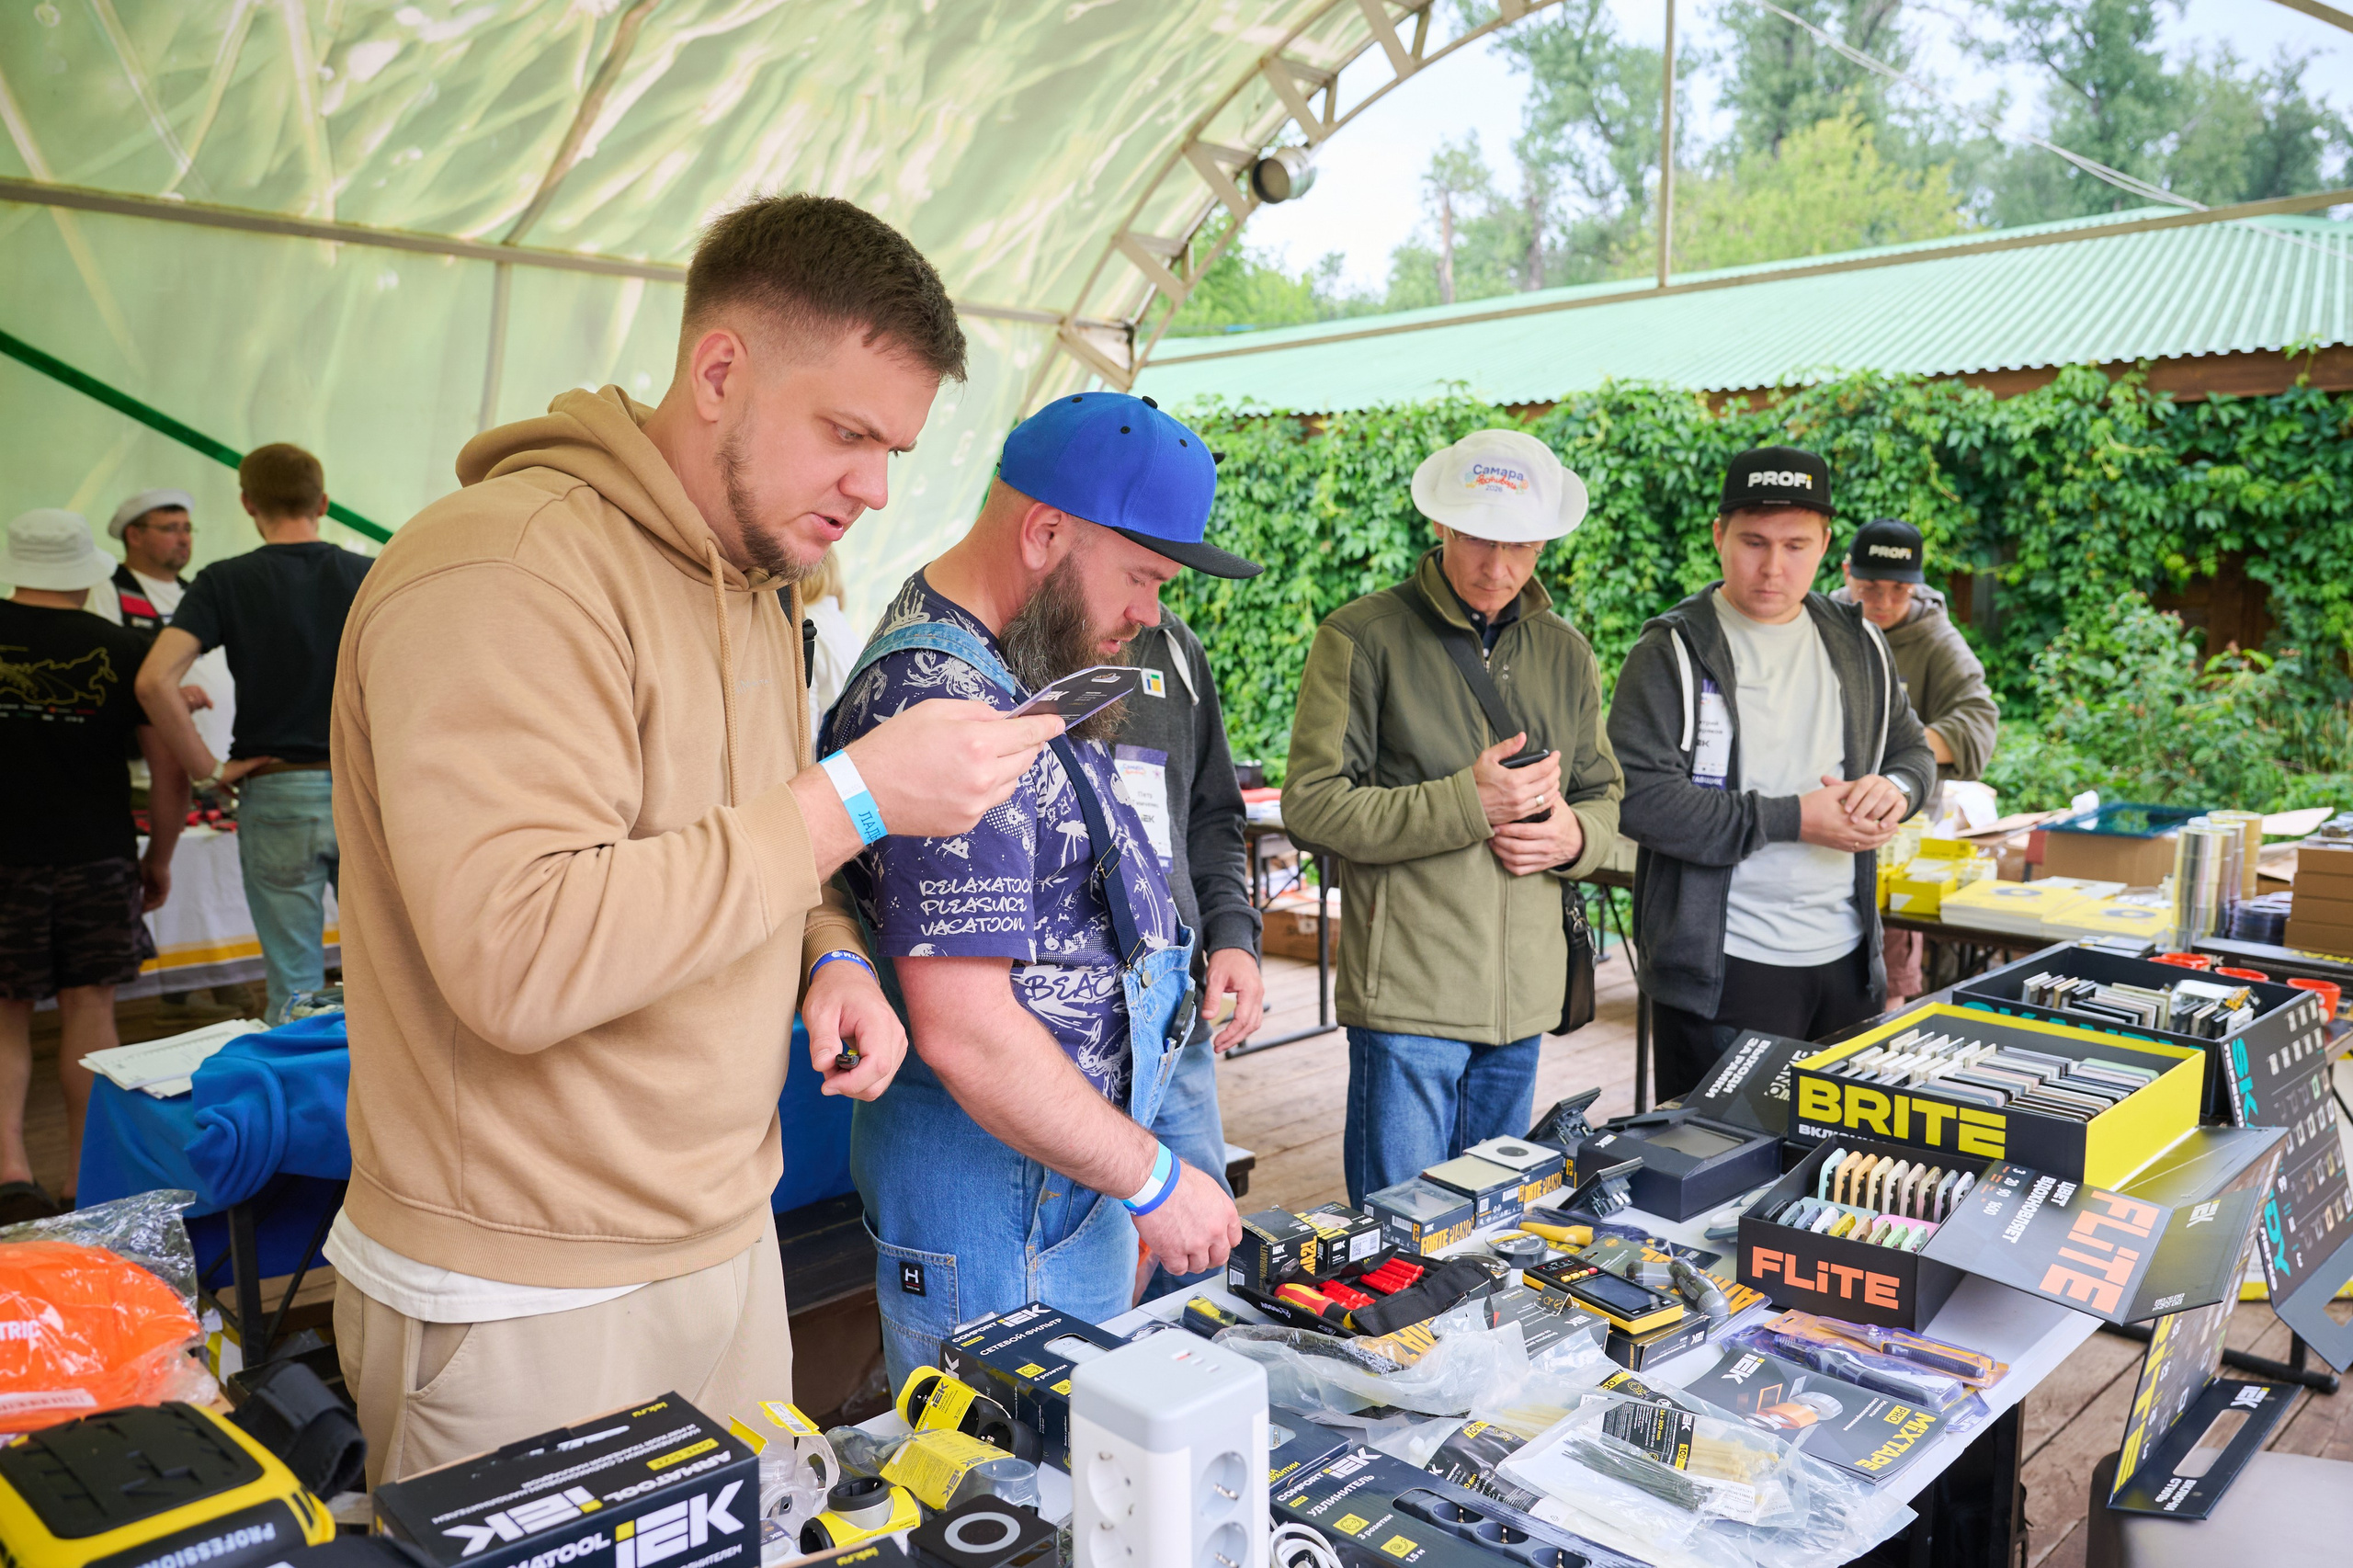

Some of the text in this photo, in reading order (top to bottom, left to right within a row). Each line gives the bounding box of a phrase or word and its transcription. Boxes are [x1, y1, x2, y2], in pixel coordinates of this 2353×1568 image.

[1473, 464, 1524, 481] Самара
[1692, 776, 1722, 786] ТАВЩИК
[920, 896, 1028, 916] PLEASURE
[1705, 1036, 1760, 1098] ЗА РАМКИ
[1723, 1040, 1772, 1094] ВЫХОДИ
[2223, 1044, 2244, 1129] ПЕРЕКЛ
[1798, 1075, 2006, 1160] BRITE
[1524, 1180, 1542, 1204] ORTE
[2051, 1181, 2077, 1207] ЦВЕТ
[2002, 1176, 2057, 1244] ВДОХНОВЛЯЕТ
[1421, 1228, 1449, 1256] FORTE
[1259, 1244, 1268, 1280] WARRANTY
[904, 1267, 919, 1284] H
[0, 1320, 40, 1340] TRIC
[952, 1322, 997, 1343] COMFORT
[980, 1317, 1063, 1356] СЕТЕВОЙ ФИЛЬТР
[1040, 1364, 1067, 1380] розетки
[1602, 1380, 1616, 1390] 00
[1889, 1407, 1907, 1422] PRO
[2113, 1313, 2175, 1494] RITE
[1467, 1423, 1482, 1437] 100
[1678, 1447, 1687, 1460] 100
[603, 1450, 731, 1503] ARMATOOL
[1269, 1461, 1301, 1483] АРАНТИИ
[1277, 1471, 1324, 1502] COMFORT
[1306, 1474, 1375, 1517] УДЛИНИТЕЛЬ
[2154, 1477, 2182, 1503] СТИЛЬ
[2163, 1480, 2197, 1511] ВКЛЮЧИ
[1358, 1513, 1393, 1540] 3 розетки
[506, 1532, 611, 1568] MATOOL
[1405, 1552, 1418, 1562] 1,5
